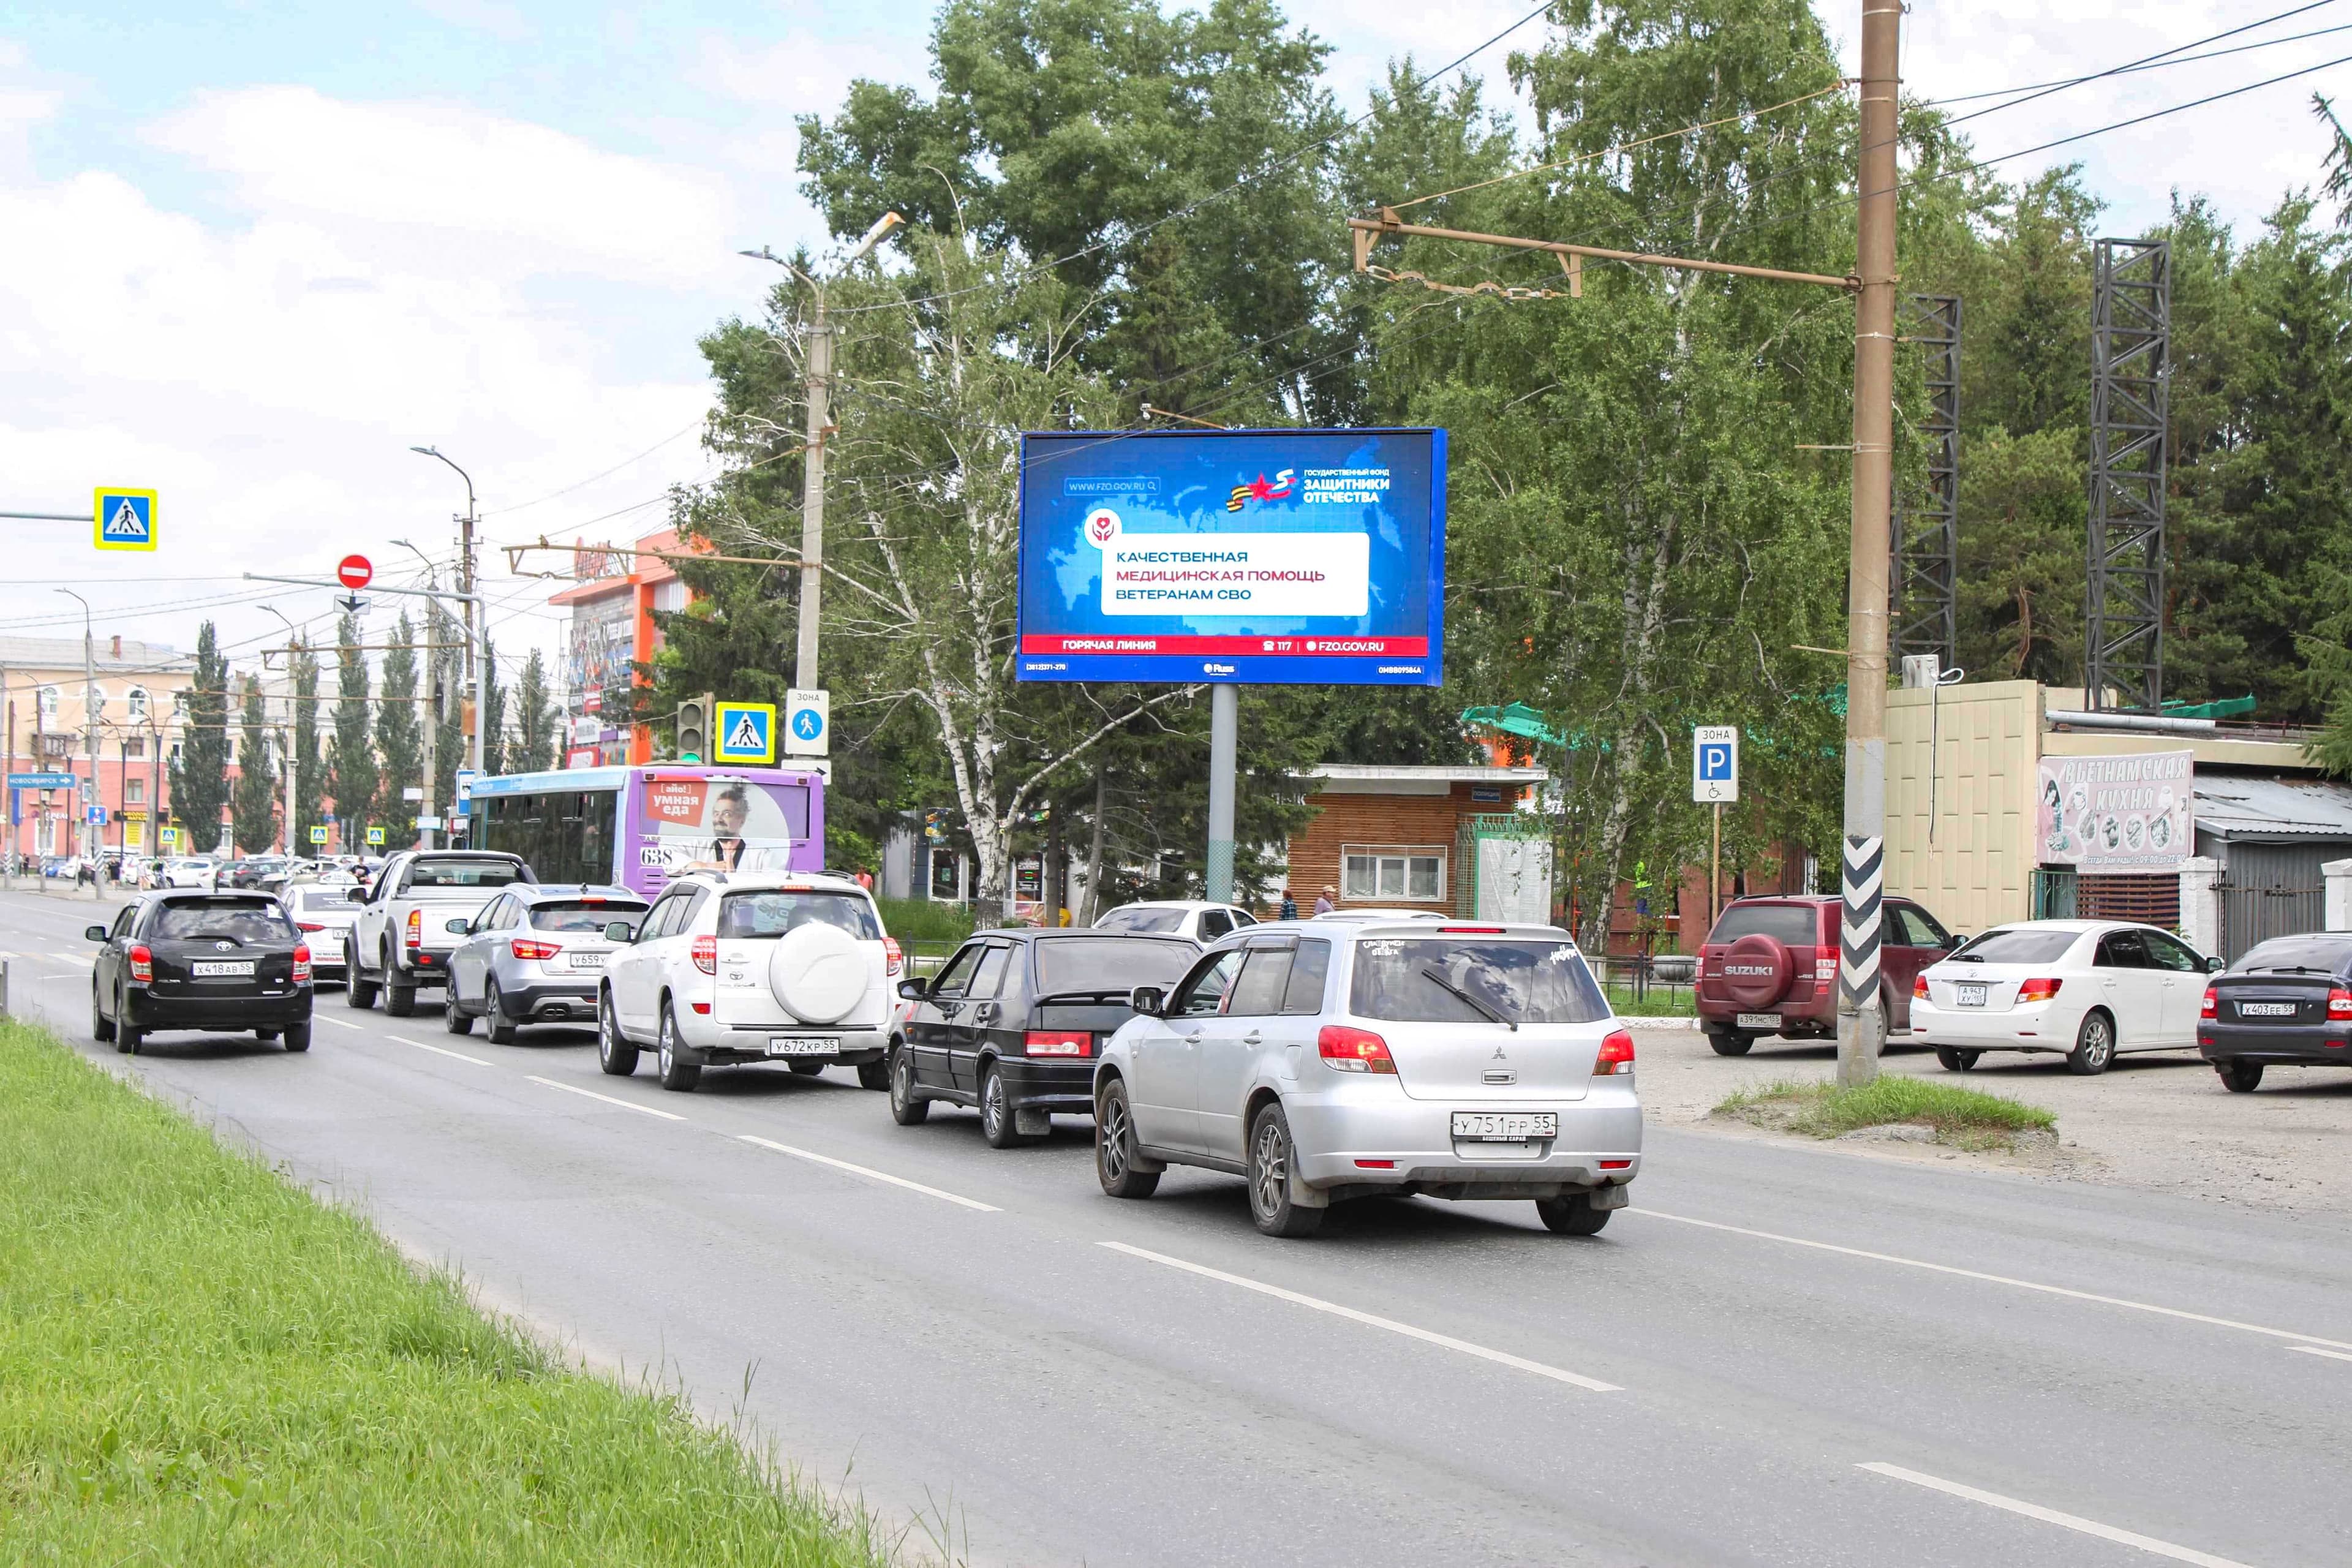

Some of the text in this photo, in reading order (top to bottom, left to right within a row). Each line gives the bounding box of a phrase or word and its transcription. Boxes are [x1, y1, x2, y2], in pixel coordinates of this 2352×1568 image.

[1303, 478, 1390, 491] ЗАЩИТНИКИ
[1303, 491, 1379, 503] ОТЕЧЕСТВА
[1117, 552, 1248, 562] КАЧЕСТВЕННАЯ
[1117, 571, 1325, 582] МЕДИЦИНСКАЯ ПОМОЩЬ
[1116, 590, 1251, 600] ВЕТЕРАНАМ СВО
[1063, 640, 1156, 650] ГОРЯЧАЯ ЛИНИЯ
[1277, 641, 1384, 652] 117 FZO.GOV.RU
[1213, 663, 1235, 673] Russ
[797, 693, 820, 701] ЗОНА
[1703, 730, 1730, 740] ЗОНА
[1707, 748, 1725, 777] P
[2064, 756, 2187, 783] ВЬЕТНАМСКАЯ
[653, 795, 699, 807] умная
[2095, 787, 2154, 812] КУХНЯ
[663, 805, 689, 816] еда
[642, 848, 673, 865] 638
[575, 955, 605, 964] У659У
[1725, 965, 1773, 976] SUZUKI
